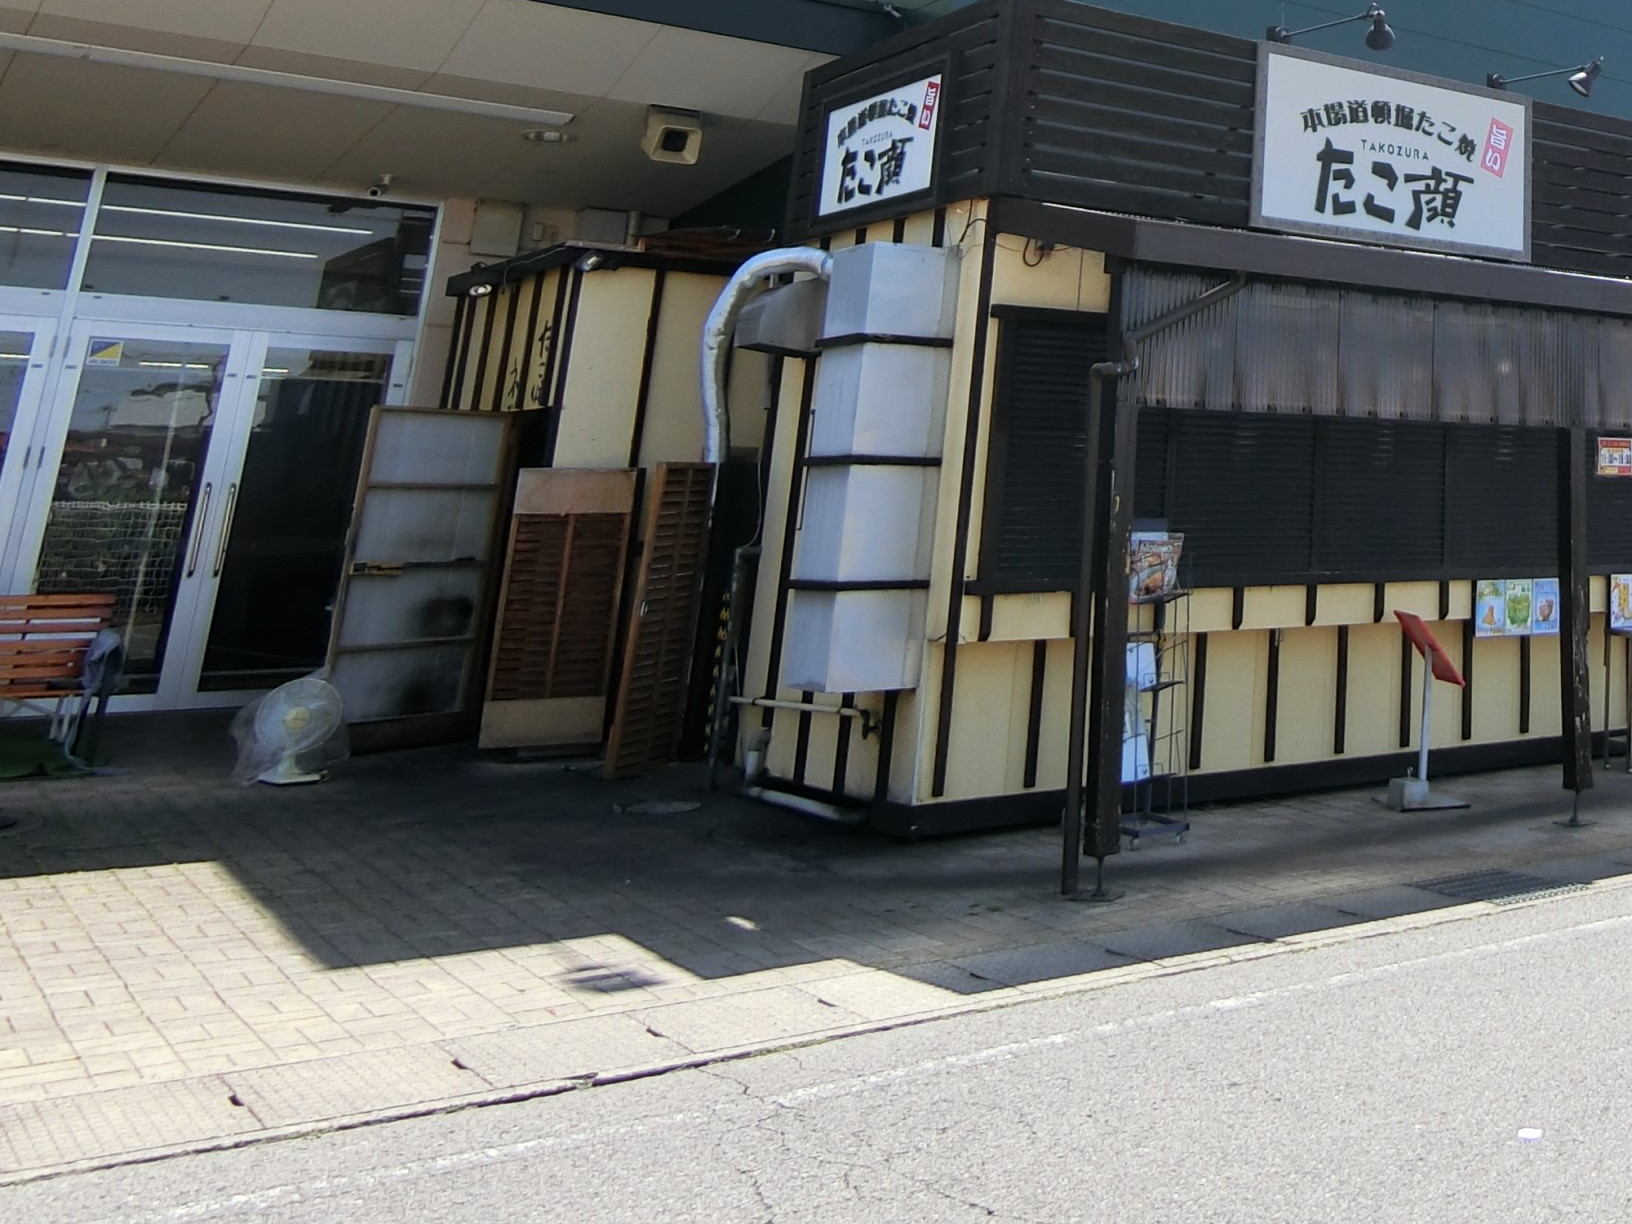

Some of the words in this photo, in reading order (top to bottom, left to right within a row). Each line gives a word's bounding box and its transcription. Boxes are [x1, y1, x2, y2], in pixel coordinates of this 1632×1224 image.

[1300, 99, 1477, 163] 本場道頓堀たこ焼
[1361, 139, 1430, 161] TAKOZURA
[1485, 123, 1508, 172] 旨い
[1314, 136, 1475, 231] たこ顔
